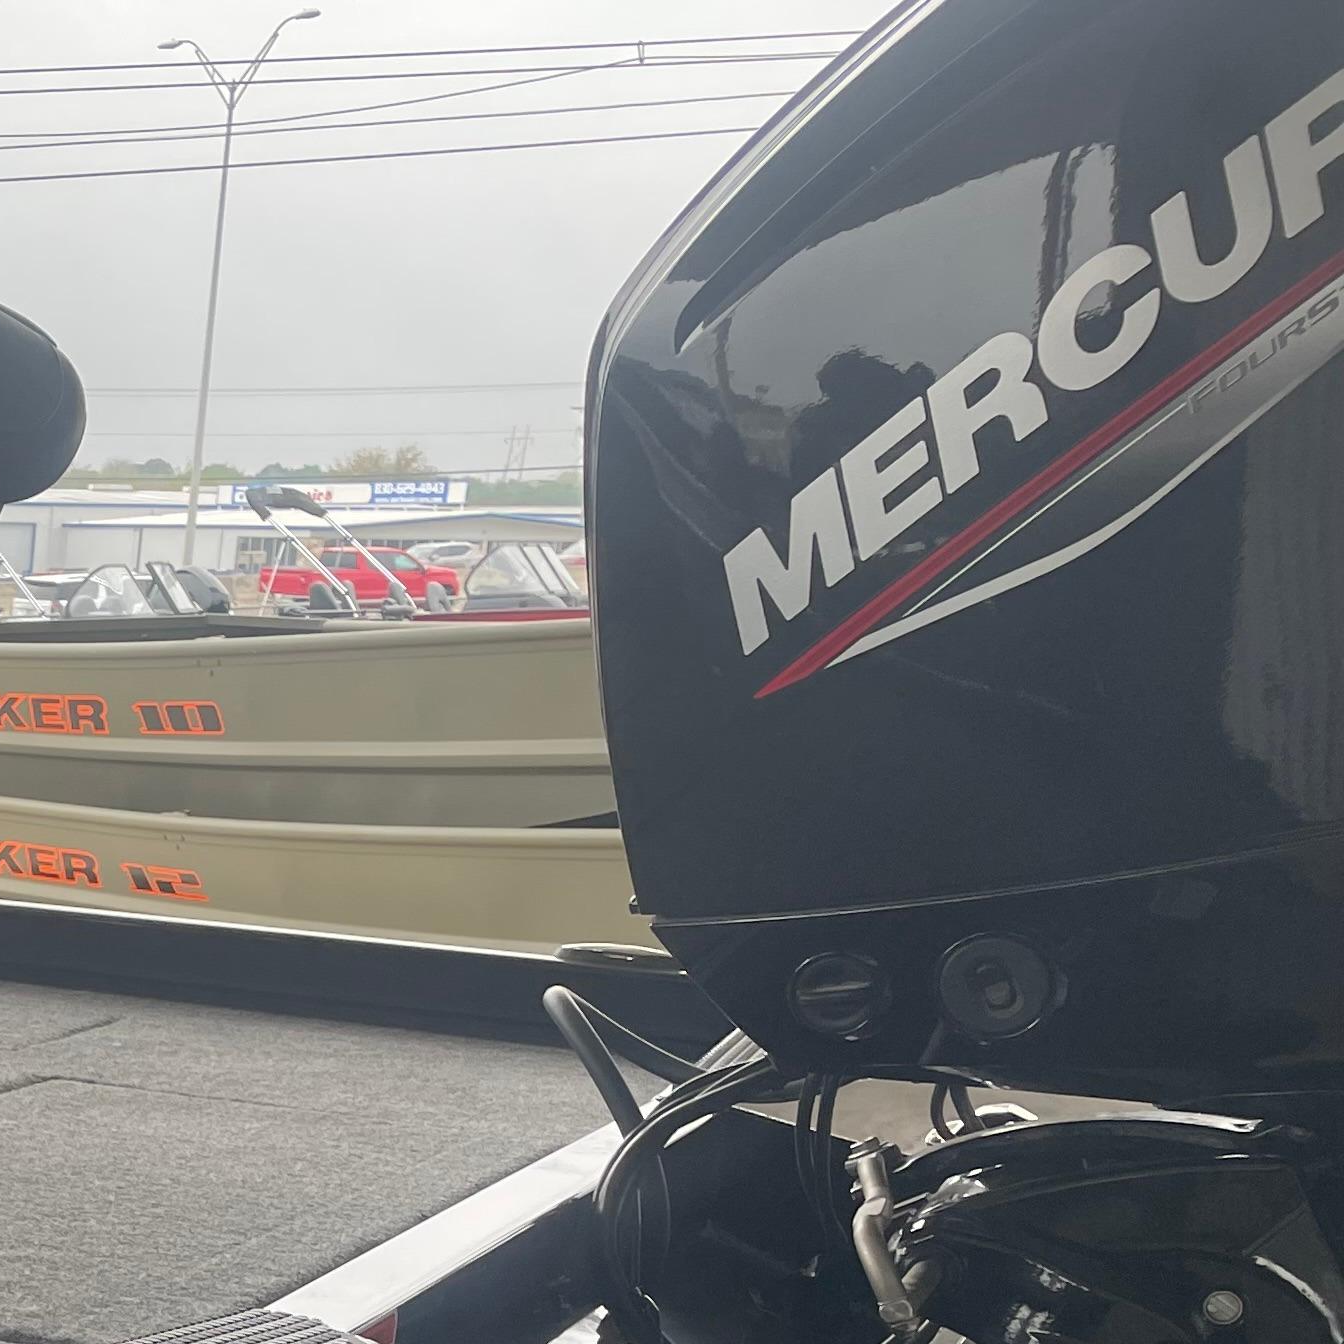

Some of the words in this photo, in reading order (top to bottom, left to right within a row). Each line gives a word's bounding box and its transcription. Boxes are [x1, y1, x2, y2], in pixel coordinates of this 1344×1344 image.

[1185, 284, 1344, 416] FOURS
[131, 700, 225, 736] 10
[121, 861, 209, 902] 12
